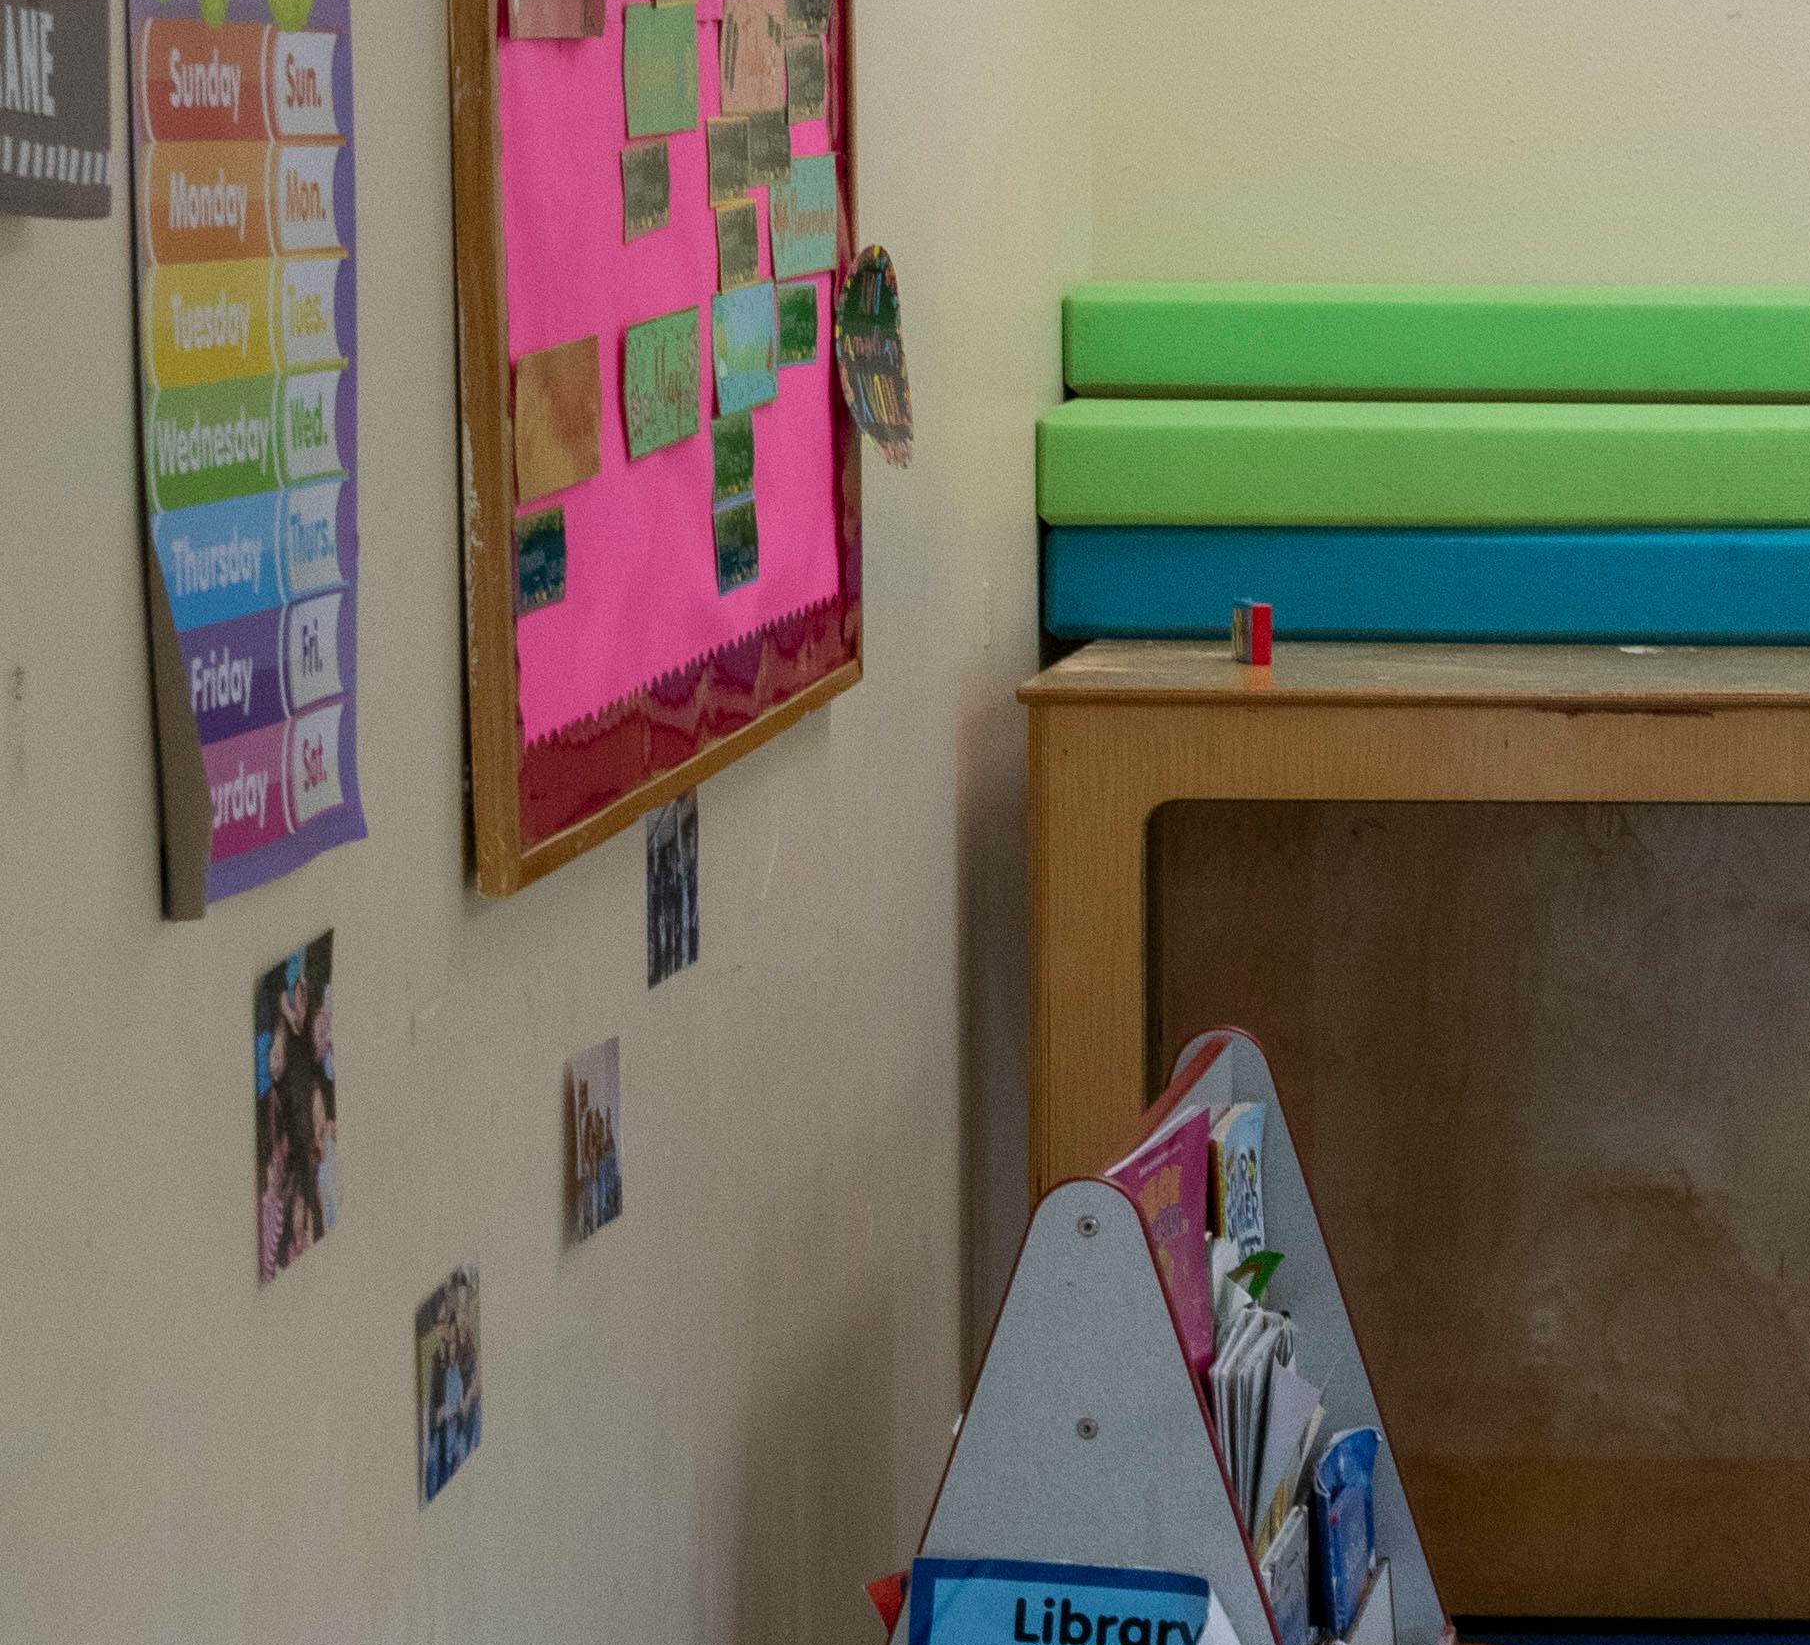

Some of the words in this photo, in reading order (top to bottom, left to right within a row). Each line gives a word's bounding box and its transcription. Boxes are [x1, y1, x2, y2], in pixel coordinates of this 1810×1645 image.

[0, 3, 55, 117] ANE
[168, 48, 242, 124] Sunday
[284, 52, 322, 109] Sun.
[168, 169, 249, 242] Monday
[284, 169, 327, 222] Mon.
[169, 291, 251, 359] Tuesday
[154, 405, 271, 477] Wednesday
[288, 397, 328, 451] Wed.
[170, 527, 262, 596] Thursday
[287, 512, 335, 566] Thurs.
[190, 646, 254, 716] Friday
[302, 619, 324, 676] Fri.
